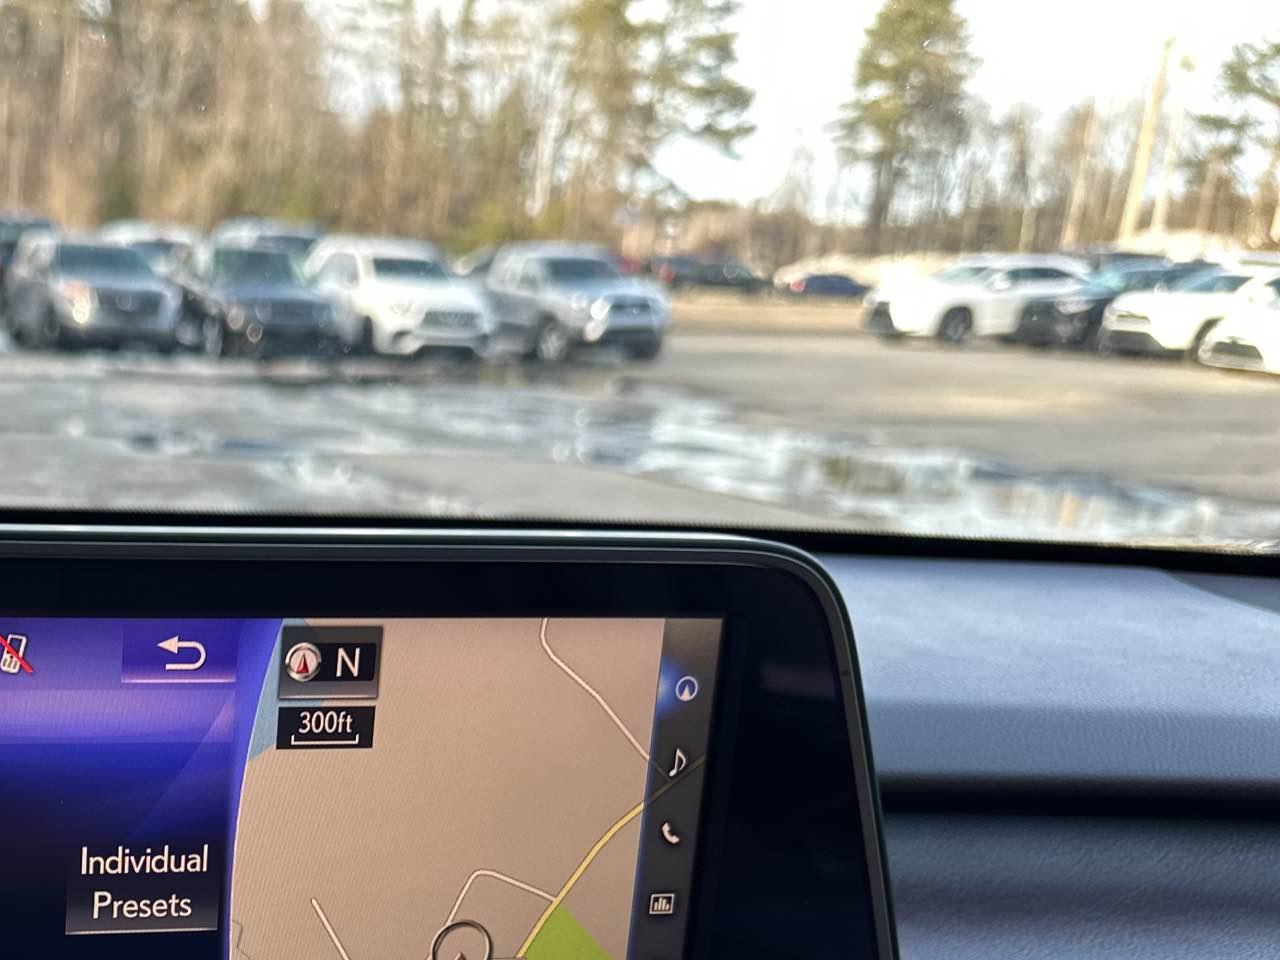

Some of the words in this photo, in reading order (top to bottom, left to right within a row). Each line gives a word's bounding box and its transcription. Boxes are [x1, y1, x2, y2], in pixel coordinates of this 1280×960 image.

[337, 648, 359, 676] N
[299, 711, 352, 733] 300ft
[82, 845, 208, 874] Individual
[94, 892, 191, 918] Presets
